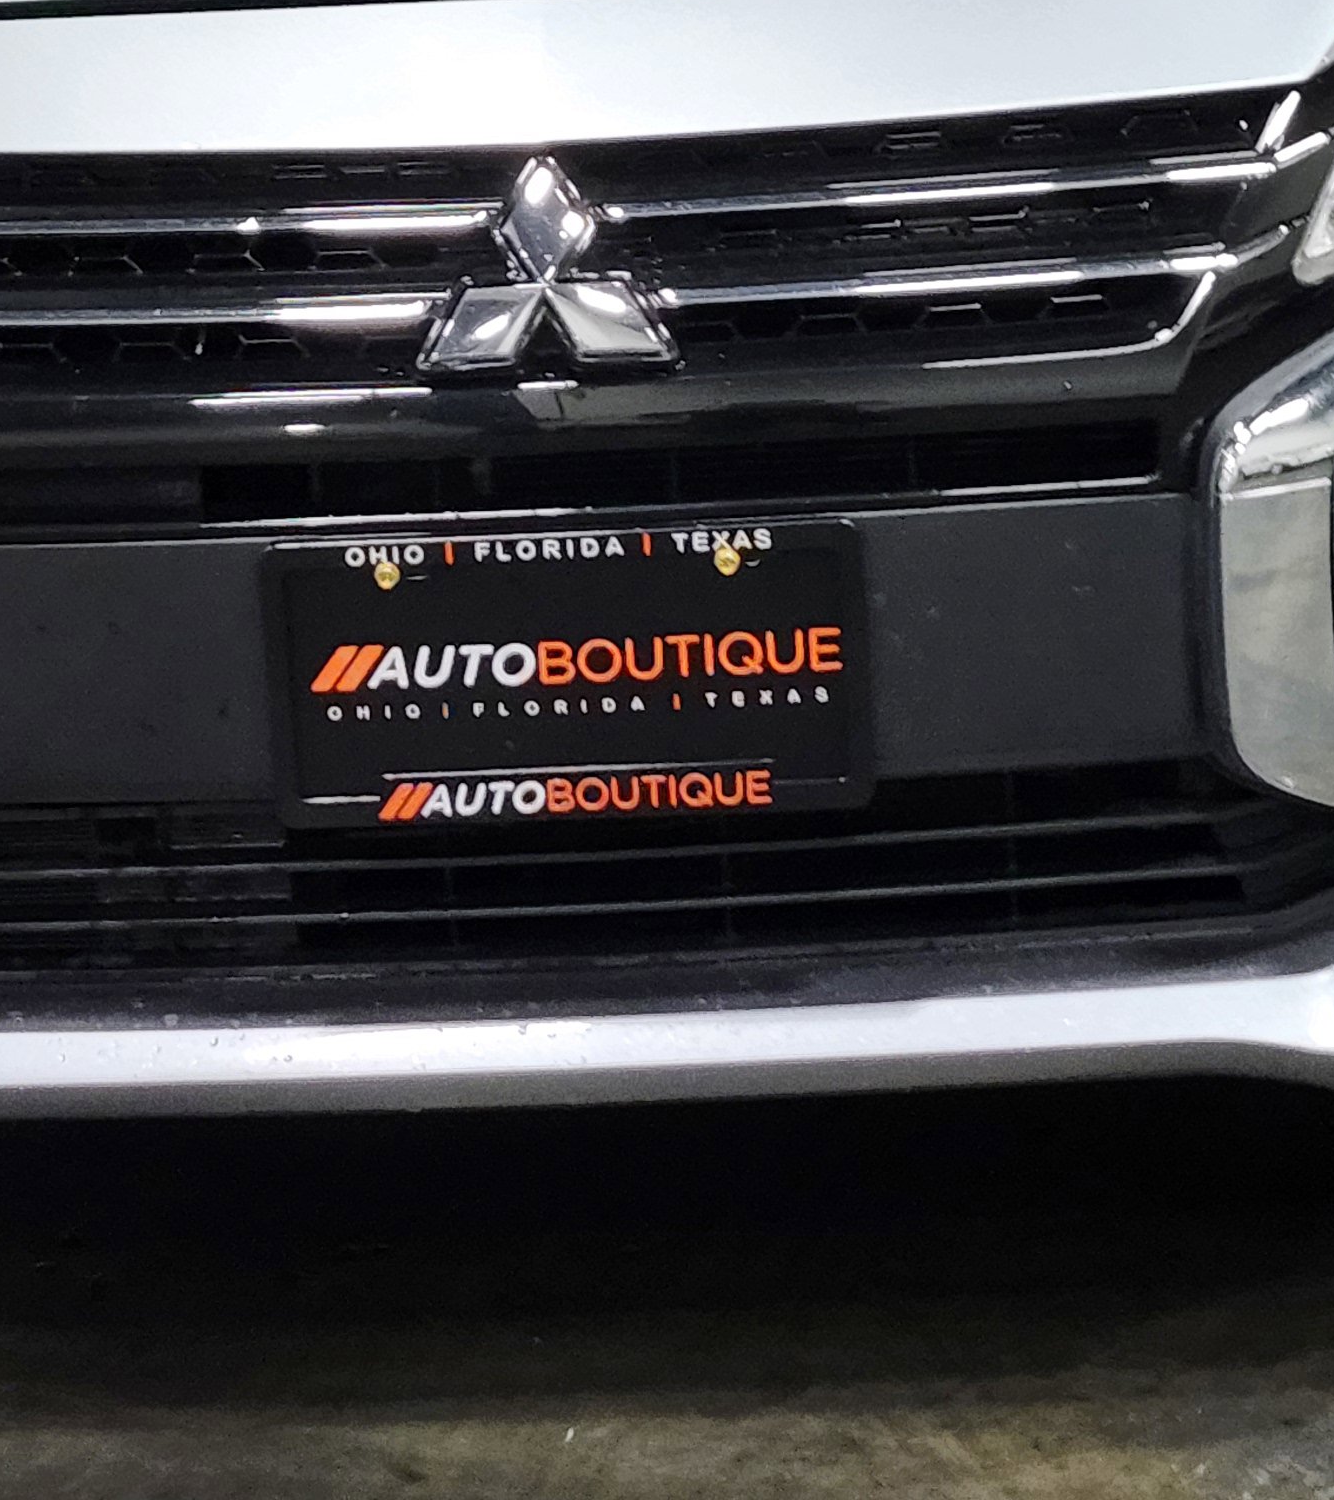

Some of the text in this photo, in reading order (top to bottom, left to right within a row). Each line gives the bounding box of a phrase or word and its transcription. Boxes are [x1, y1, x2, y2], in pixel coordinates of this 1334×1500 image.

[344, 528, 773, 569] OHIO FLORIDA TEXAS
[367, 627, 844, 690] AUTOBOUTIQUE
[326, 685, 830, 722] OHIO FLORIDA TEXAS
[419, 769, 773, 820] AUTOBOUTIQUE
